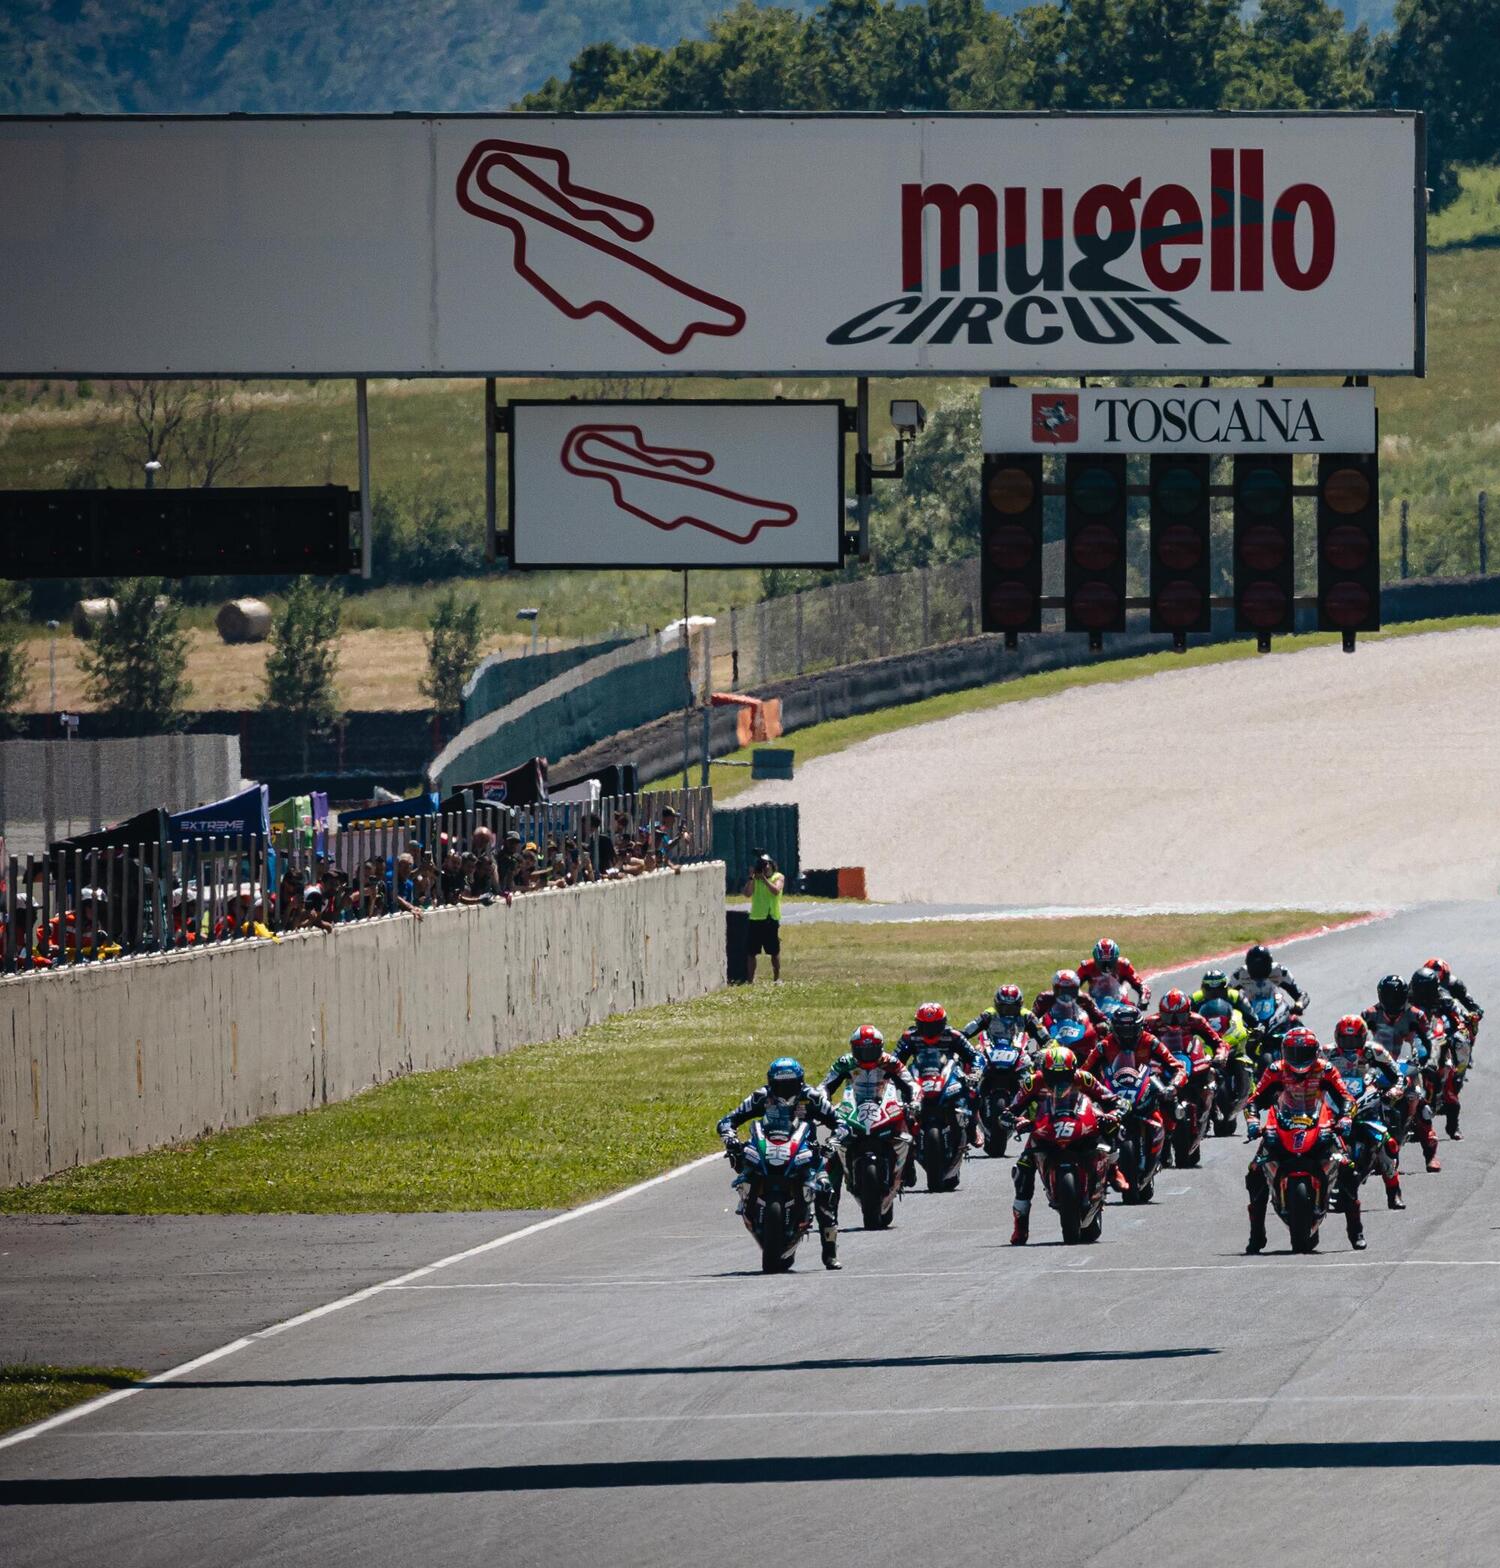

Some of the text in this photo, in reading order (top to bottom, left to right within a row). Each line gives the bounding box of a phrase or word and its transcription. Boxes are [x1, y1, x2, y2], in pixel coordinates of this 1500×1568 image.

[902, 148, 1335, 295] mugello
[826, 295, 1232, 346] CIRCUIT
[1094, 398, 1325, 443] TOSCANA
[181, 820, 244, 830] EXTREME
[921, 1079, 945, 1093] 21
[1294, 1131, 1307, 1150] 1
